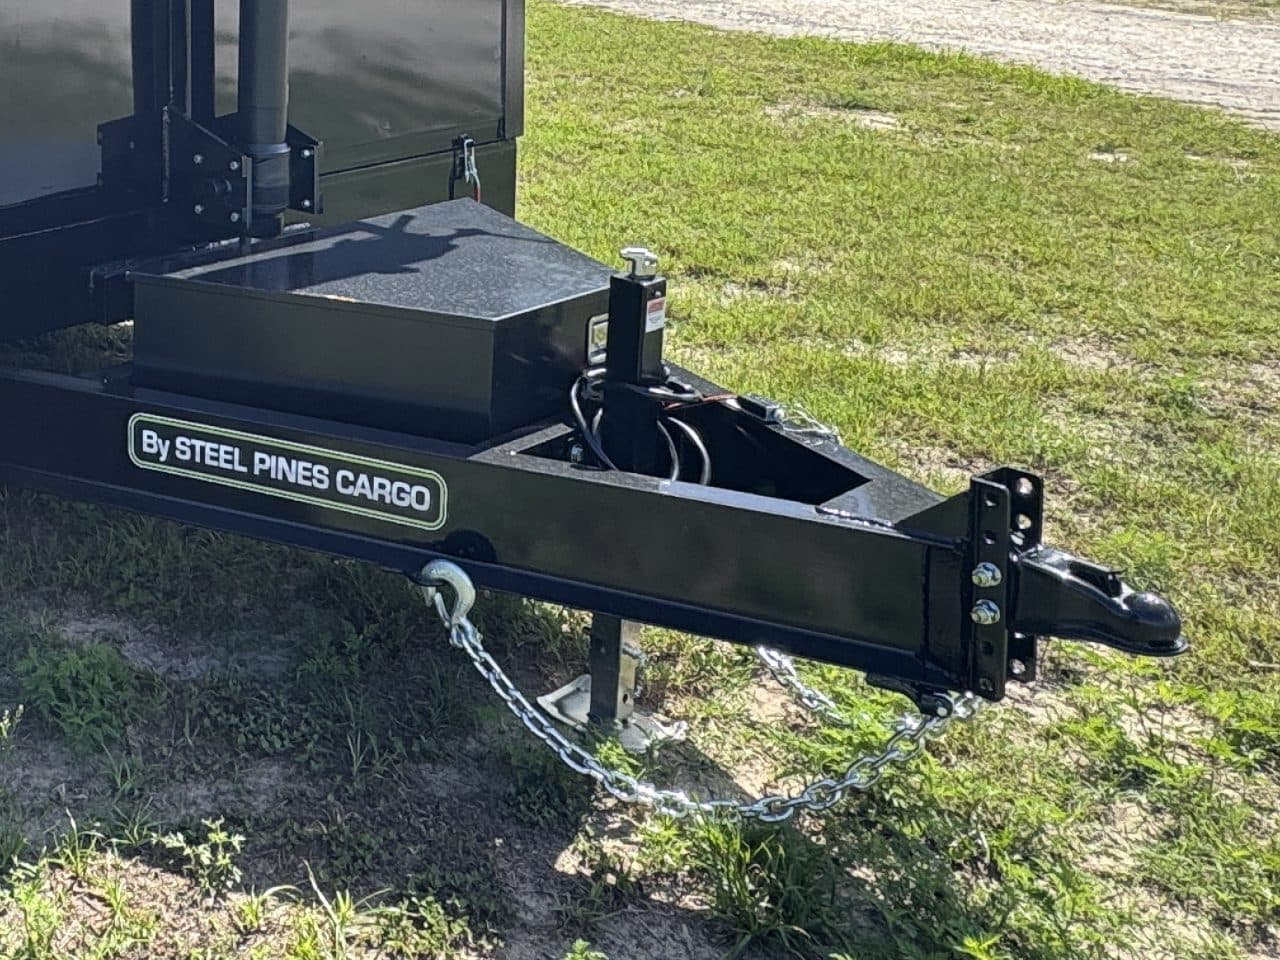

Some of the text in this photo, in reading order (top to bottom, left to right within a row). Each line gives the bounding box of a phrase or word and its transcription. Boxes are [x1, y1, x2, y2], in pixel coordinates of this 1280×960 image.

[141, 429, 431, 512] By STEEL PINES CARGO
